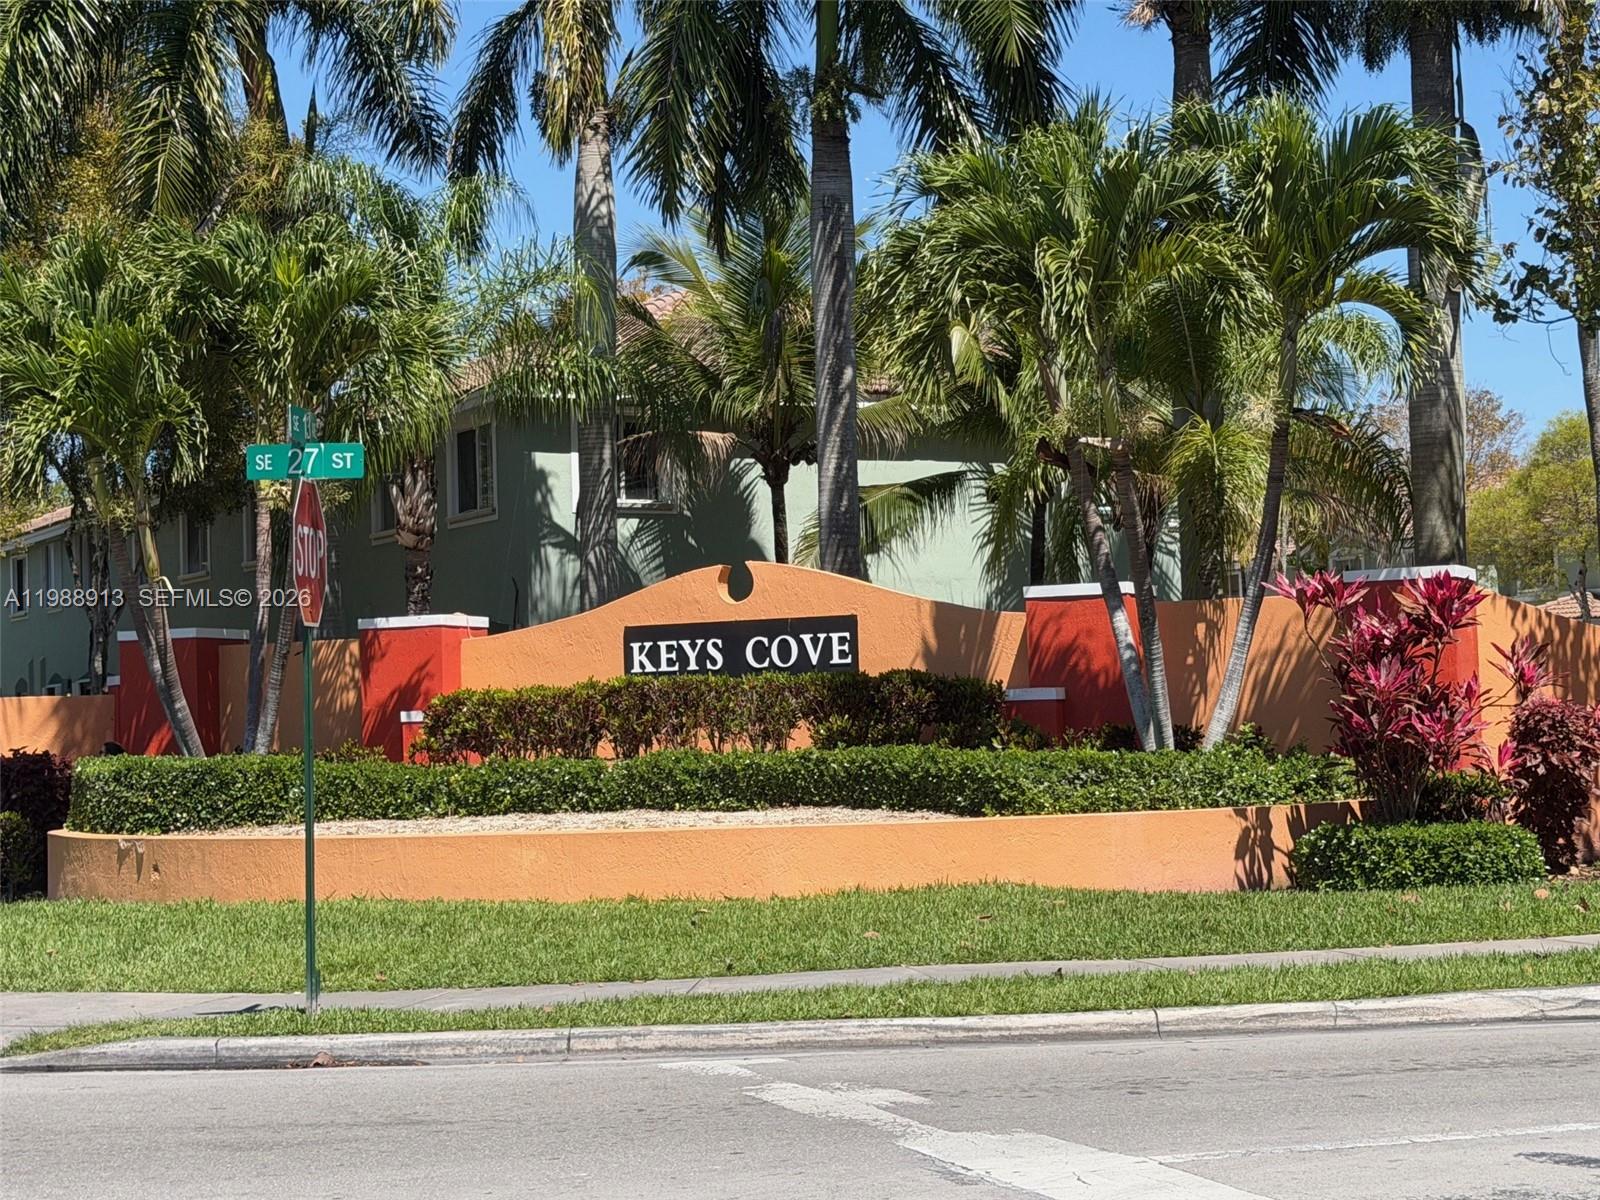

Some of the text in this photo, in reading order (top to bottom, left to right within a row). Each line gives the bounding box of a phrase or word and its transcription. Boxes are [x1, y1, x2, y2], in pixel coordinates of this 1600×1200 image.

[255, 447, 354, 475] SE 27 ST
[296, 524, 324, 579] STOP
[629, 631, 852, 674] KEYS COVE
